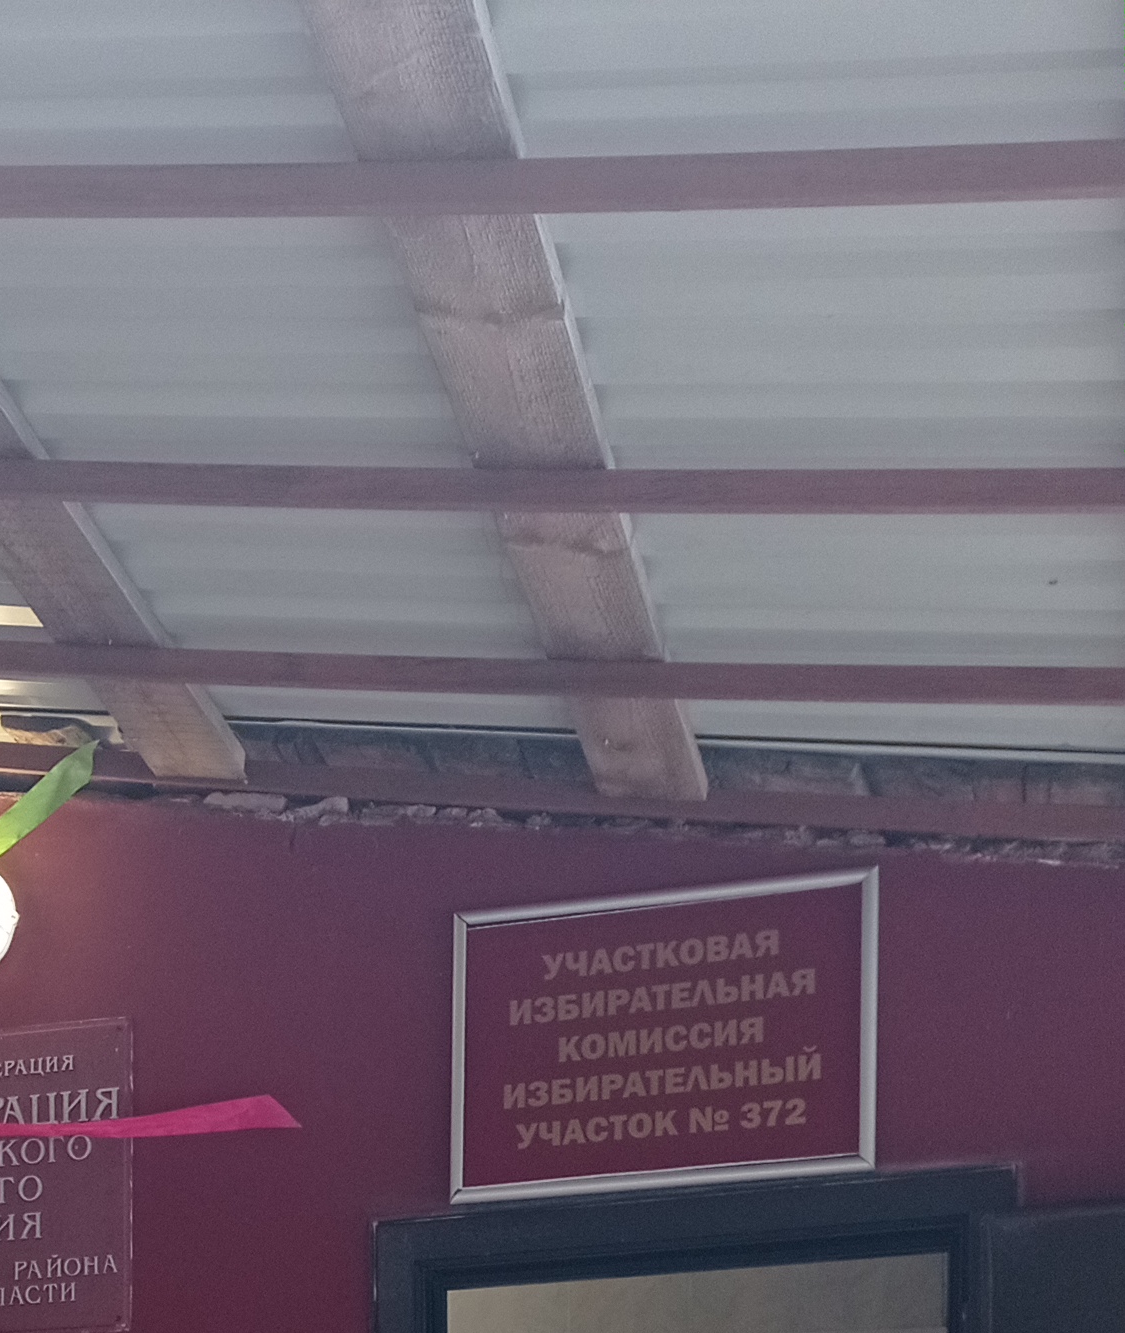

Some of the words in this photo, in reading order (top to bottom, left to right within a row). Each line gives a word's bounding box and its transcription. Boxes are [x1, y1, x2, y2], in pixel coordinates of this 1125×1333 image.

[542, 929, 780, 981] УЧАСТКОВАЯ
[509, 968, 817, 1026] ИЗБИРАТЕЛЬНАЯ
[558, 1016, 765, 1063] КОМИССИЯ
[503, 1045, 823, 1110] ИЗБИРАТЕЛЬНЫЙ
[516, 1110, 678, 1150] УЧАСТОК
[688, 1106, 729, 1134] №
[740, 1098, 807, 1130] 372
[14, 1254, 118, 1280] РАЙОНА
